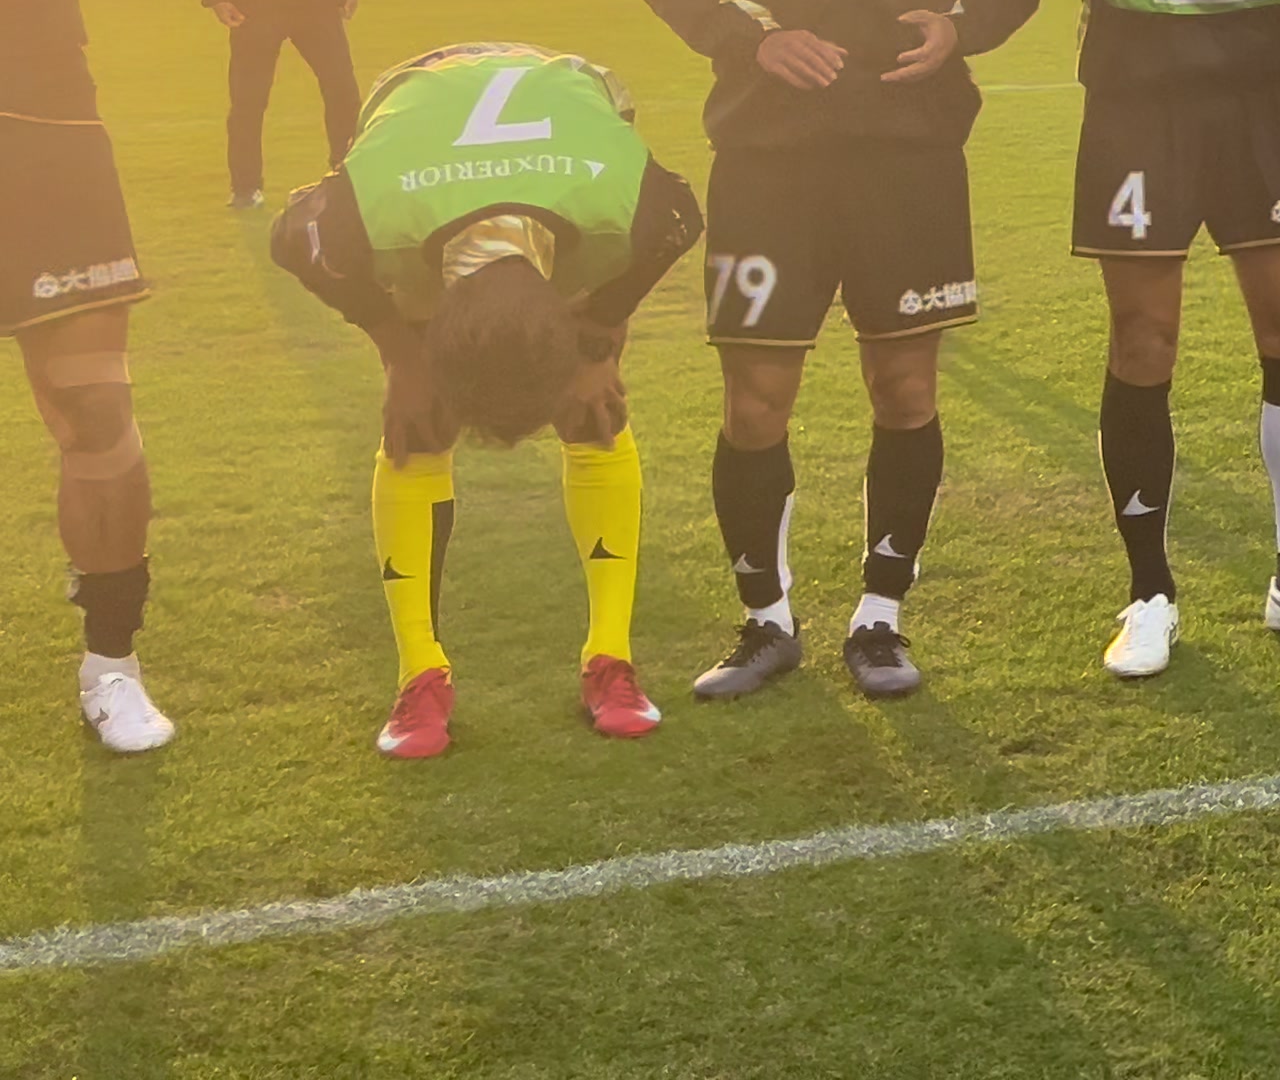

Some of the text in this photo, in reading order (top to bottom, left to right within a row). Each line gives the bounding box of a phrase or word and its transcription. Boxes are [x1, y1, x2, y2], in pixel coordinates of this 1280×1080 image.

[452, 66, 552, 147] 7
[398, 154, 574, 192] LUXPERIOR
[1108, 171, 1152, 240] 4
[708, 254, 777, 327] 79
